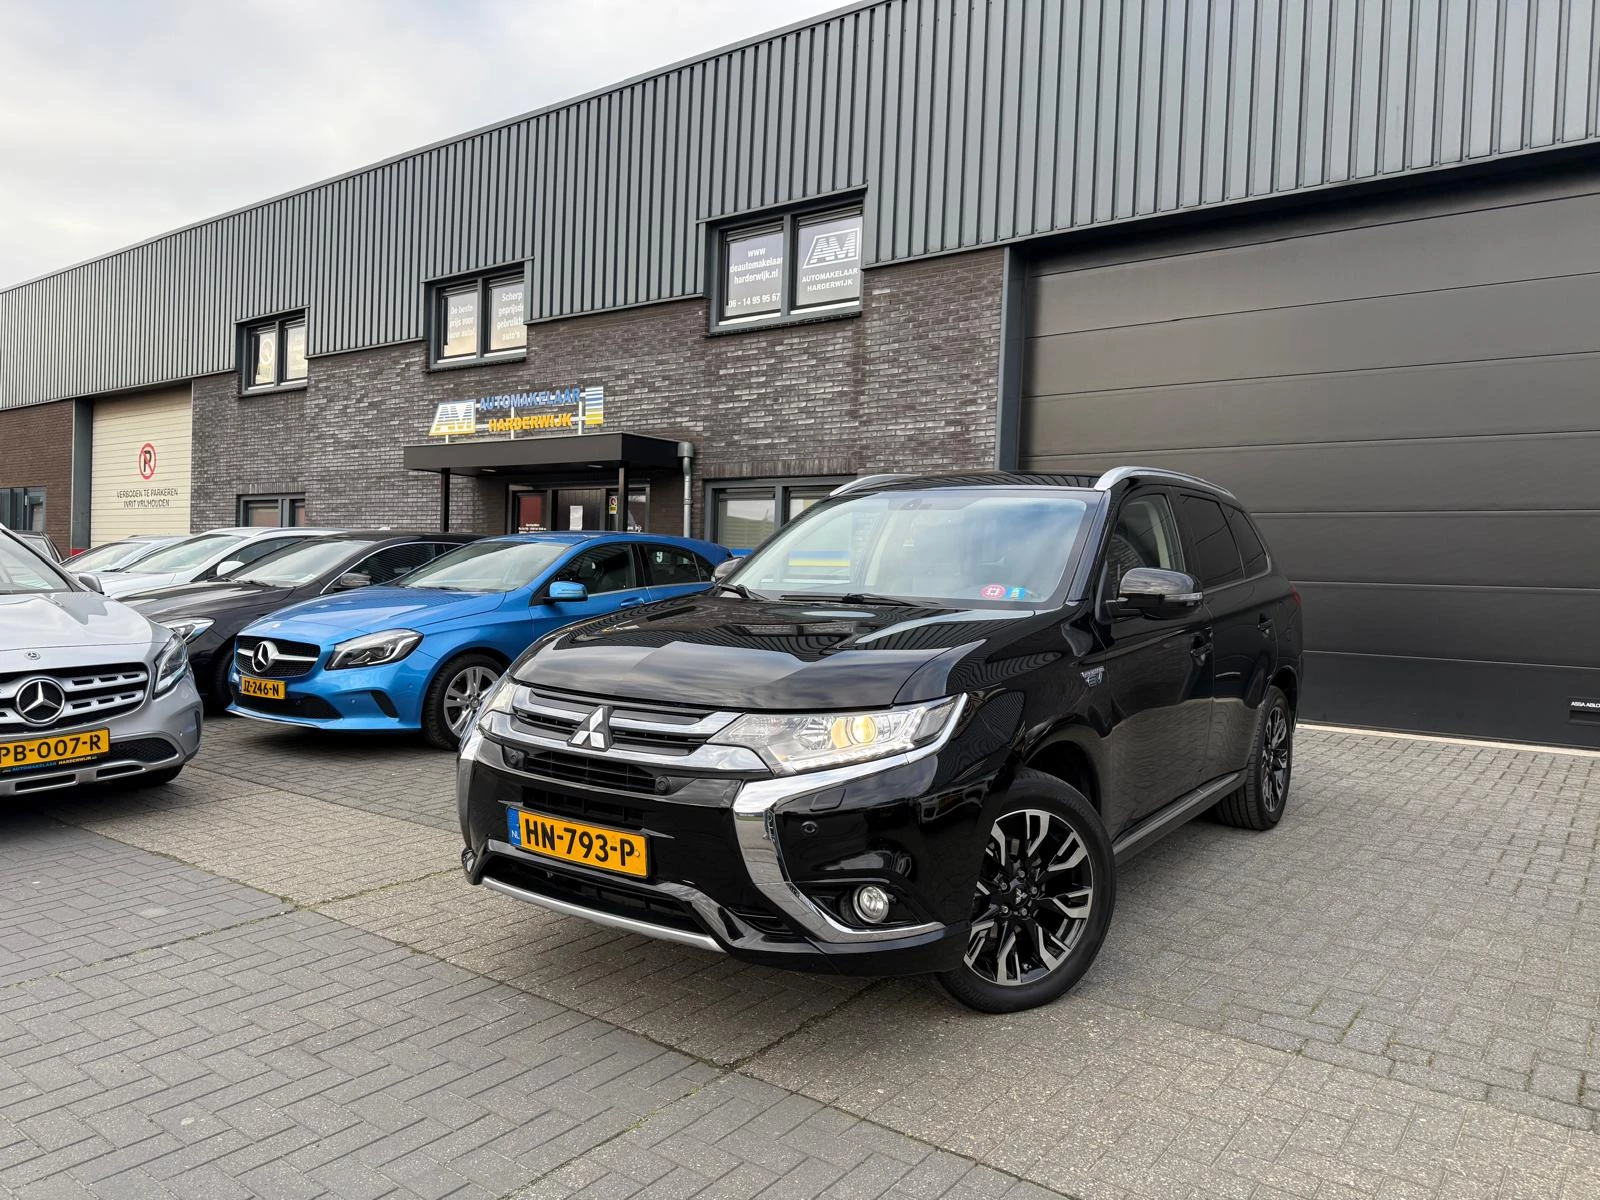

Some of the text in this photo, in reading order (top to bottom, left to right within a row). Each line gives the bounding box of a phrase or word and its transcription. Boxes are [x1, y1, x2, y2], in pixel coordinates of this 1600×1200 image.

[747, 247, 767, 258] www
[729, 256, 783, 273] deautomakelaar
[733, 268, 779, 285] harderwijk.nl
[801, 267, 859, 283] AUTOMAKELAAR
[806, 278, 854, 292] HARDERWIJK
[752, 295, 761, 305] 95
[761, 294, 771, 303] 95
[771, 292, 781, 302] 67
[478, 387, 581, 411] AUTOMAKELAAR
[488, 413, 573, 432] HARDERWIJK
[116, 487, 179, 499] VERBODEN TE PARKEREN
[243, 679, 280, 697] JZ-246-N
[0, 734, 102, 764] PB-007-R
[511, 829, 520, 840] NL
[524, 818, 635, 867] HN-793-P
